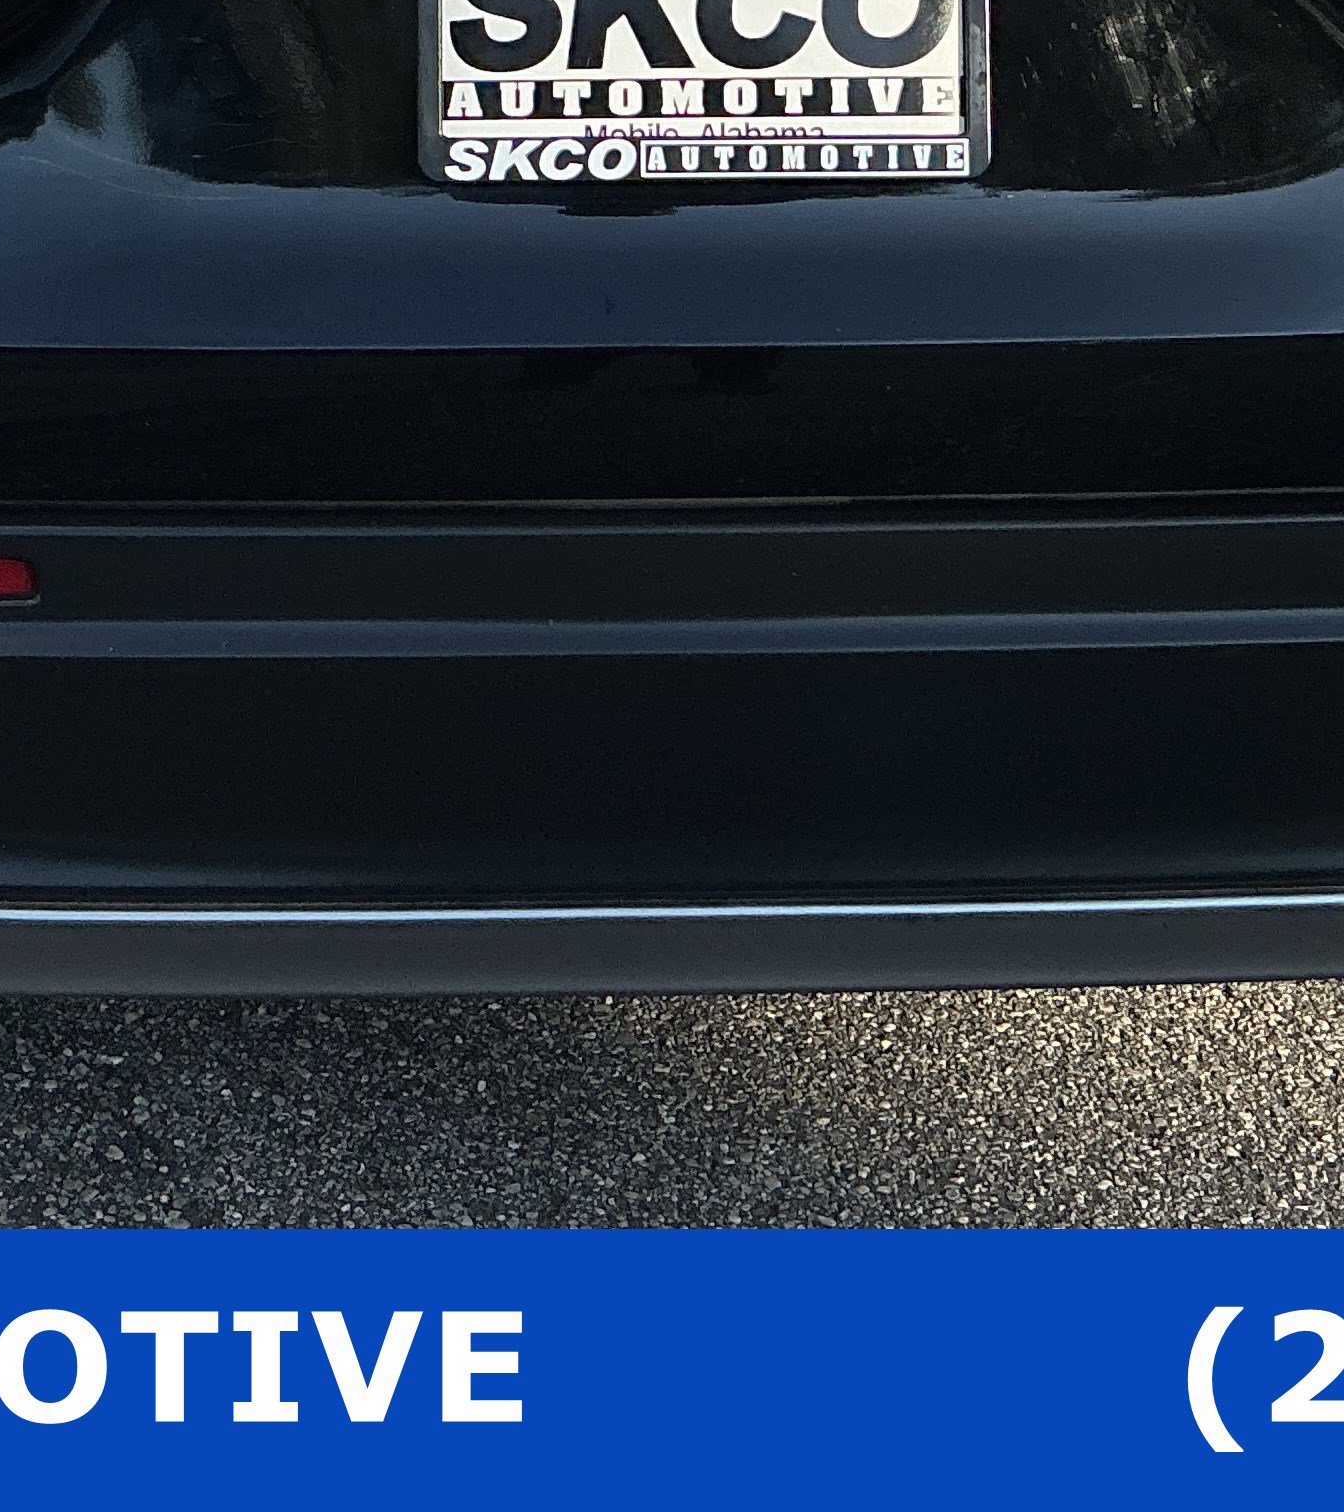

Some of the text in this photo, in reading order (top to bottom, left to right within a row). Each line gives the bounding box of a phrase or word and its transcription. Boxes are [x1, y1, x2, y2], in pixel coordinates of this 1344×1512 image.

[447, 78, 956, 118] AUTOMOTIVE
[584, 122, 680, 137] Mobil
[444, 138, 965, 181] SKCO AUTOMOTIVE
